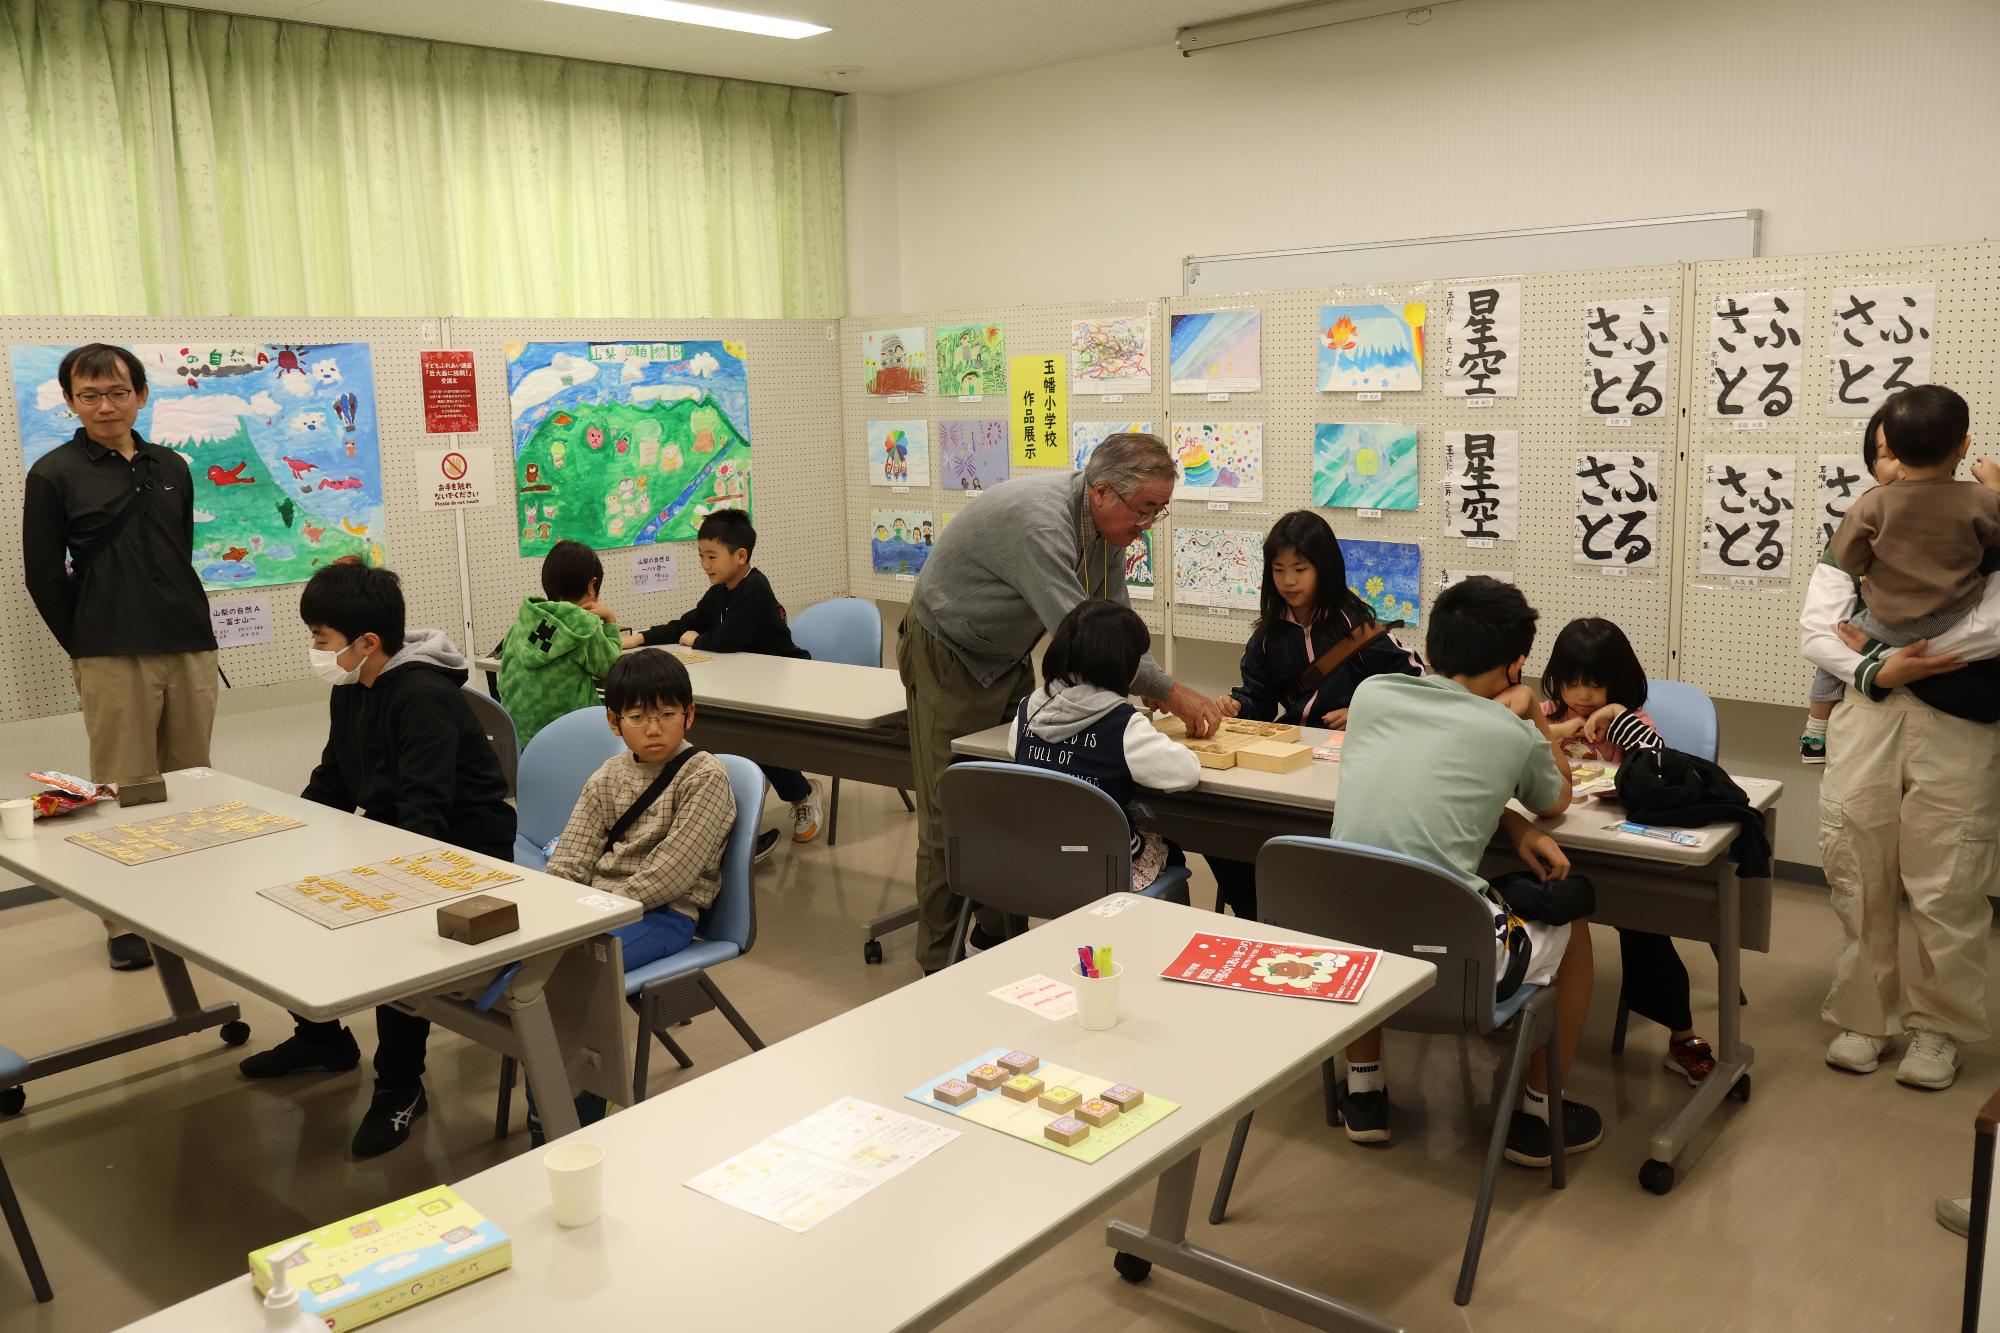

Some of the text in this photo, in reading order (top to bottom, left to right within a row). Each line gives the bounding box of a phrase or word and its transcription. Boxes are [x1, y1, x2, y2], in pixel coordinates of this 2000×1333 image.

[1459, 289, 1507, 395] 星空
[1023, 390, 1037, 460] 作品展示
[1043, 359, 1057, 448] 玉幡小学校
[433, 490, 480, 500] ないでください
[438, 482, 473, 492] お手を触れ
[1459, 433, 1501, 538] 星空
[1028, 745, 1074, 765] FULL OF
[1084, 733, 1097, 748] IS
